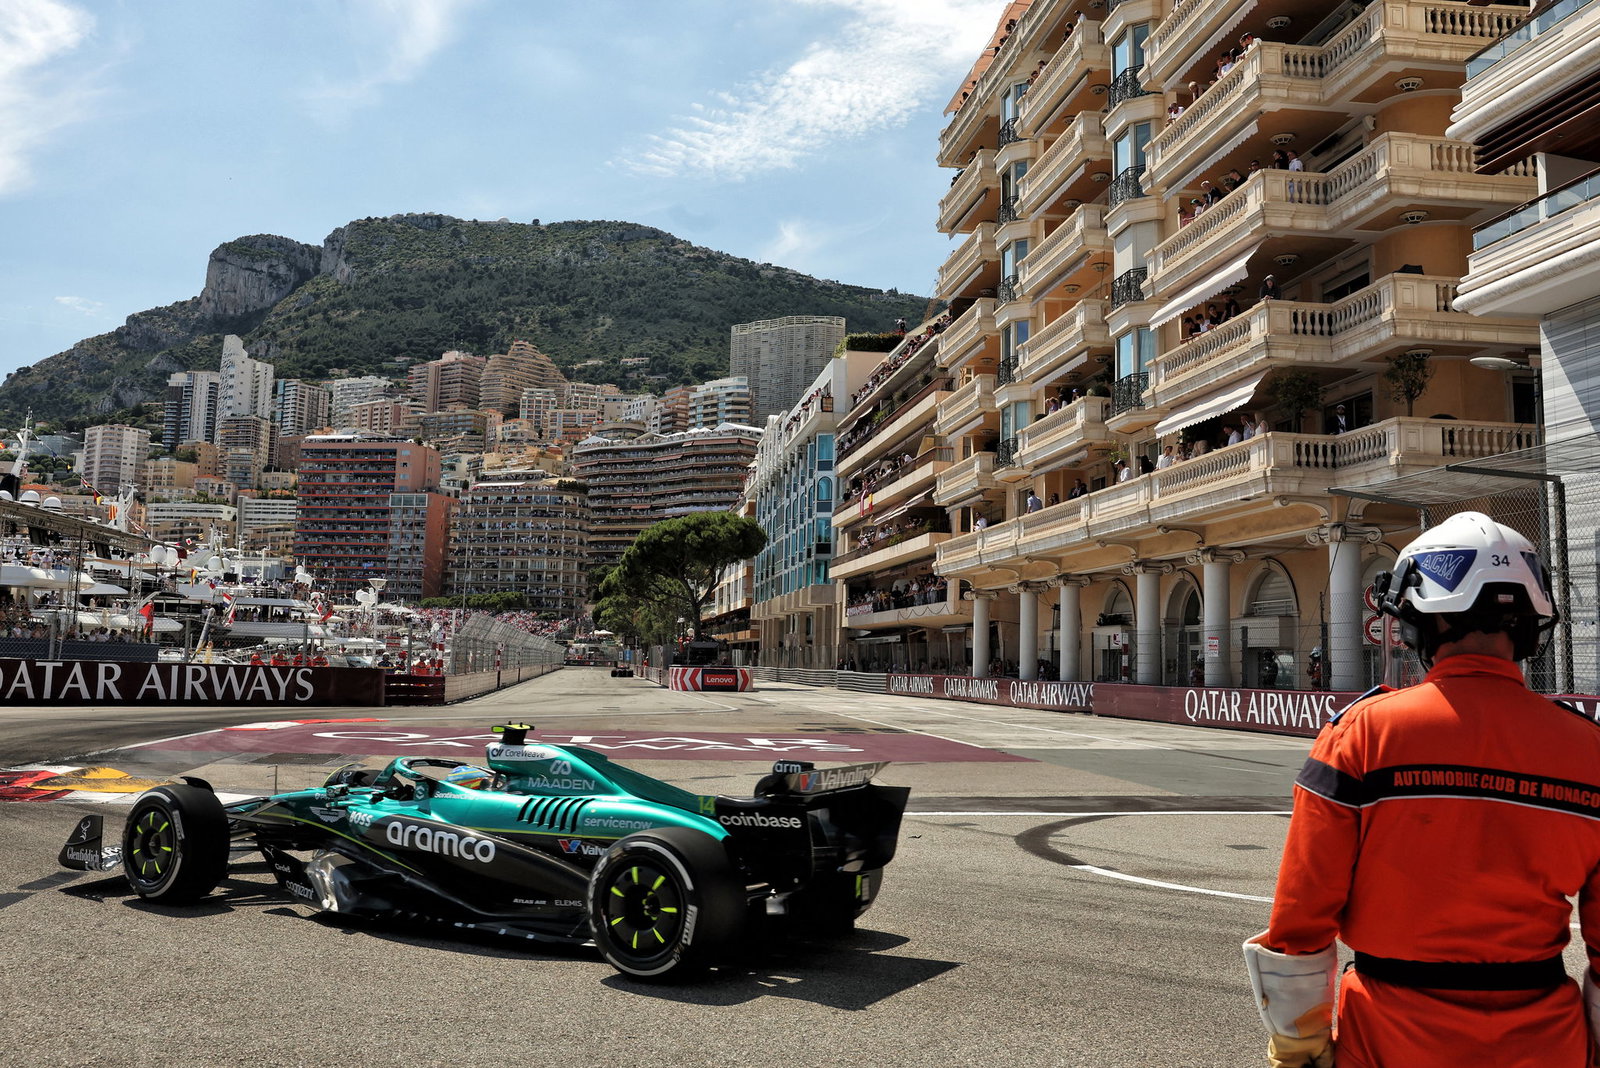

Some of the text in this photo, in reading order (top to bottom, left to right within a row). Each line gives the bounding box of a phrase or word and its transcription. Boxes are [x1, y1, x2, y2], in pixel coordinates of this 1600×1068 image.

[1420, 554, 1464, 580] ACM
[1491, 555, 1510, 567] 34
[0, 661, 314, 701] ATAR AIRWAYS
[889, 675, 934, 694] QATAR AIRWAYS
[943, 678, 998, 700] QATAR AIRWAYS
[1010, 681, 1039, 704] QATAR
[1185, 689, 1242, 722] QATAR
[505, 749, 546, 759] CoreWeave
[774, 762, 802, 774] arm
[527, 777, 596, 791] MAADEN
[1393, 770, 1600, 808] AUTOMOBILE CLUB DE MONACO
[698, 796, 716, 815] 14
[349, 810, 374, 827] BOSS
[584, 816, 653, 830] servicenow
[719, 811, 802, 829] coinbase
[386, 821, 496, 863] aramco
[580, 845, 608, 856] Valv
[66, 846, 100, 863] Glenfiddich
[285, 879, 315, 900] cognizant
[554, 899, 583, 907] ELEMIS
